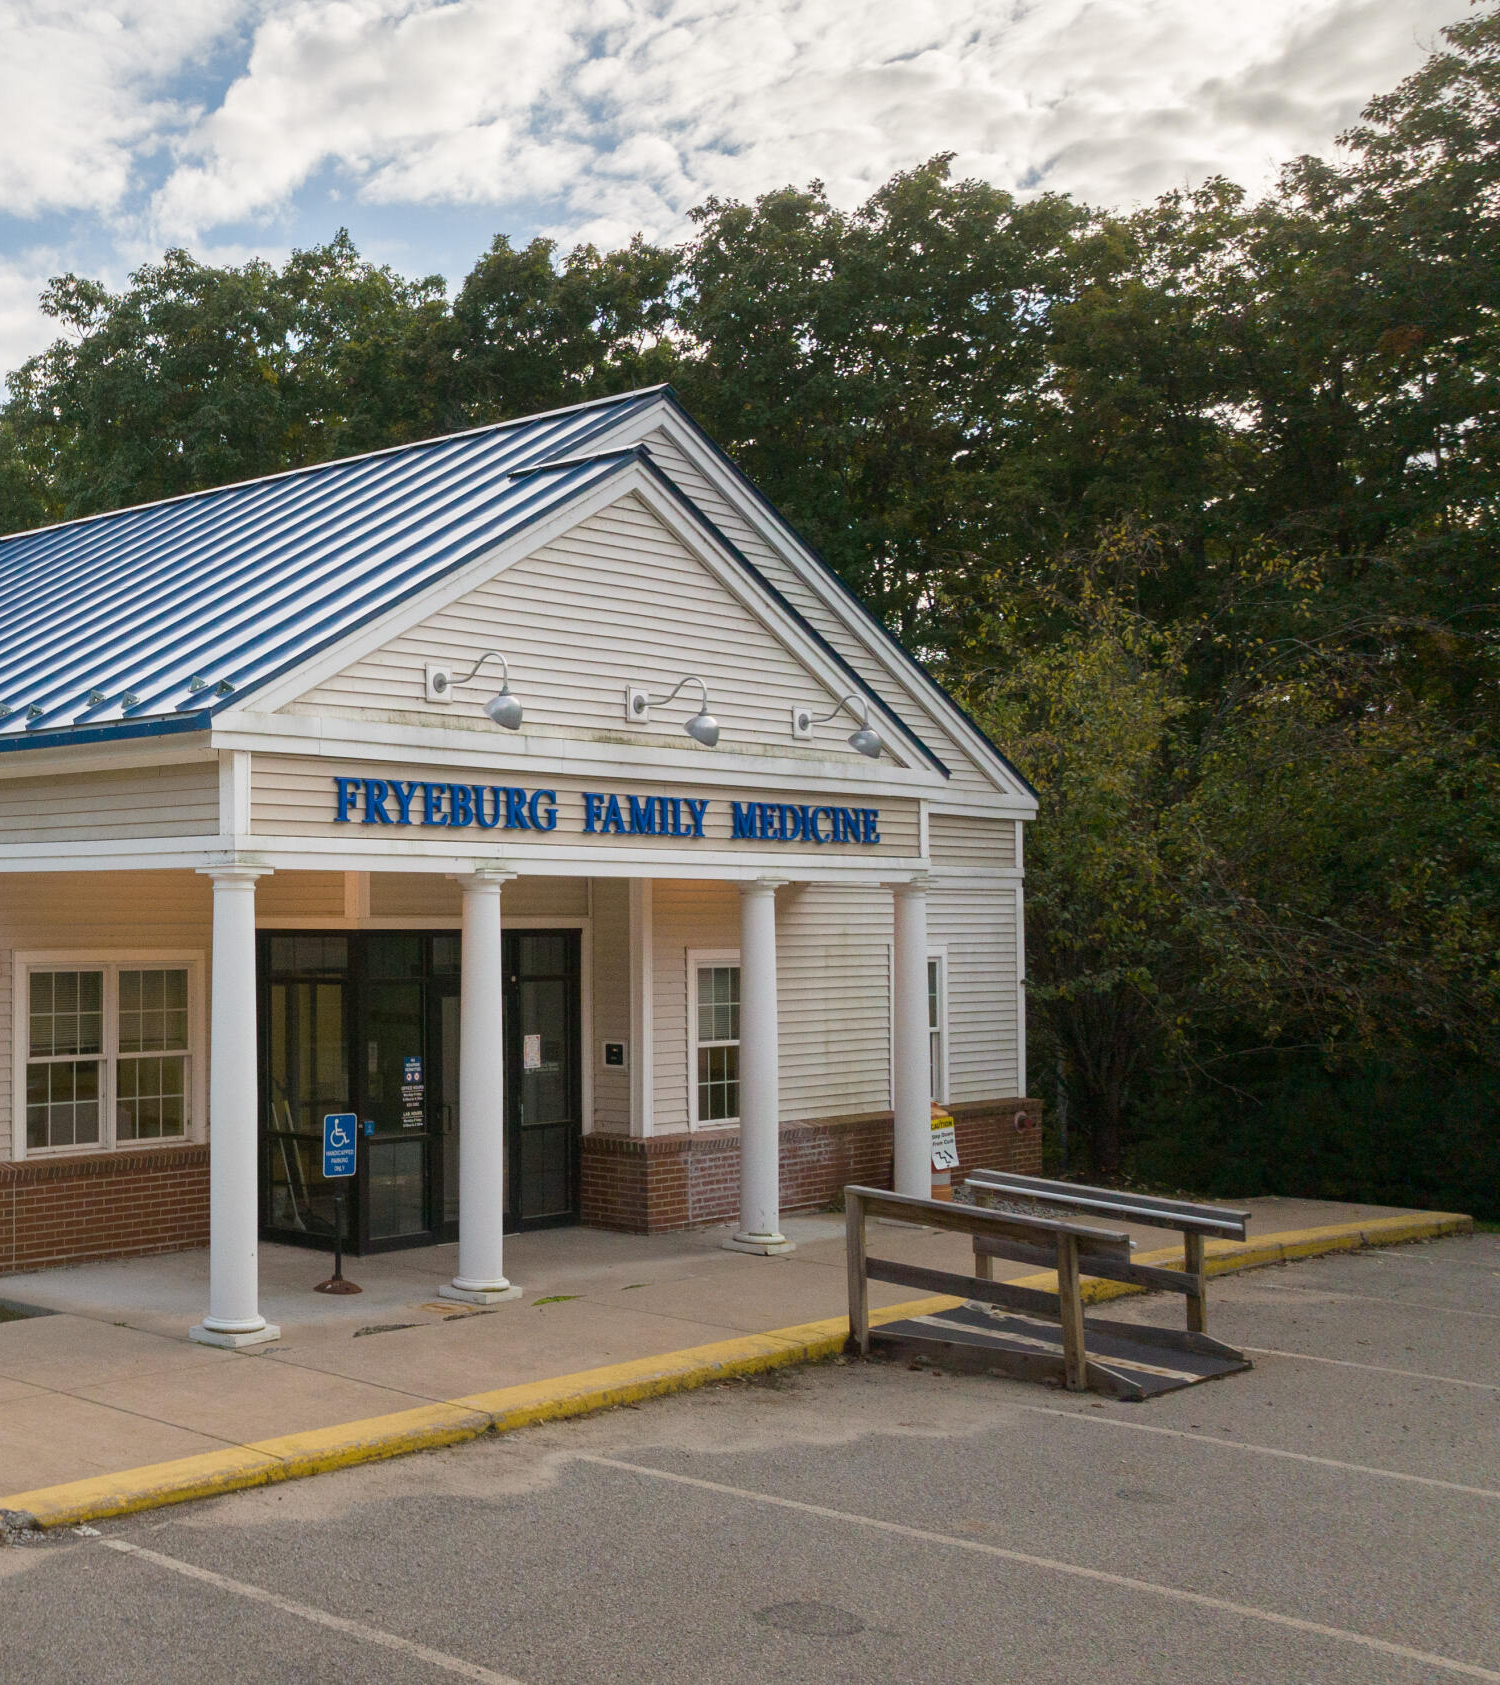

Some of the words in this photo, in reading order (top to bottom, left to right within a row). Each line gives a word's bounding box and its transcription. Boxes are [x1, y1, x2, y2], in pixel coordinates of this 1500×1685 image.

[333, 776, 558, 832] FRYEBURG
[582, 792, 710, 838] FAMILY
[730, 801, 881, 845] MEDICINE
